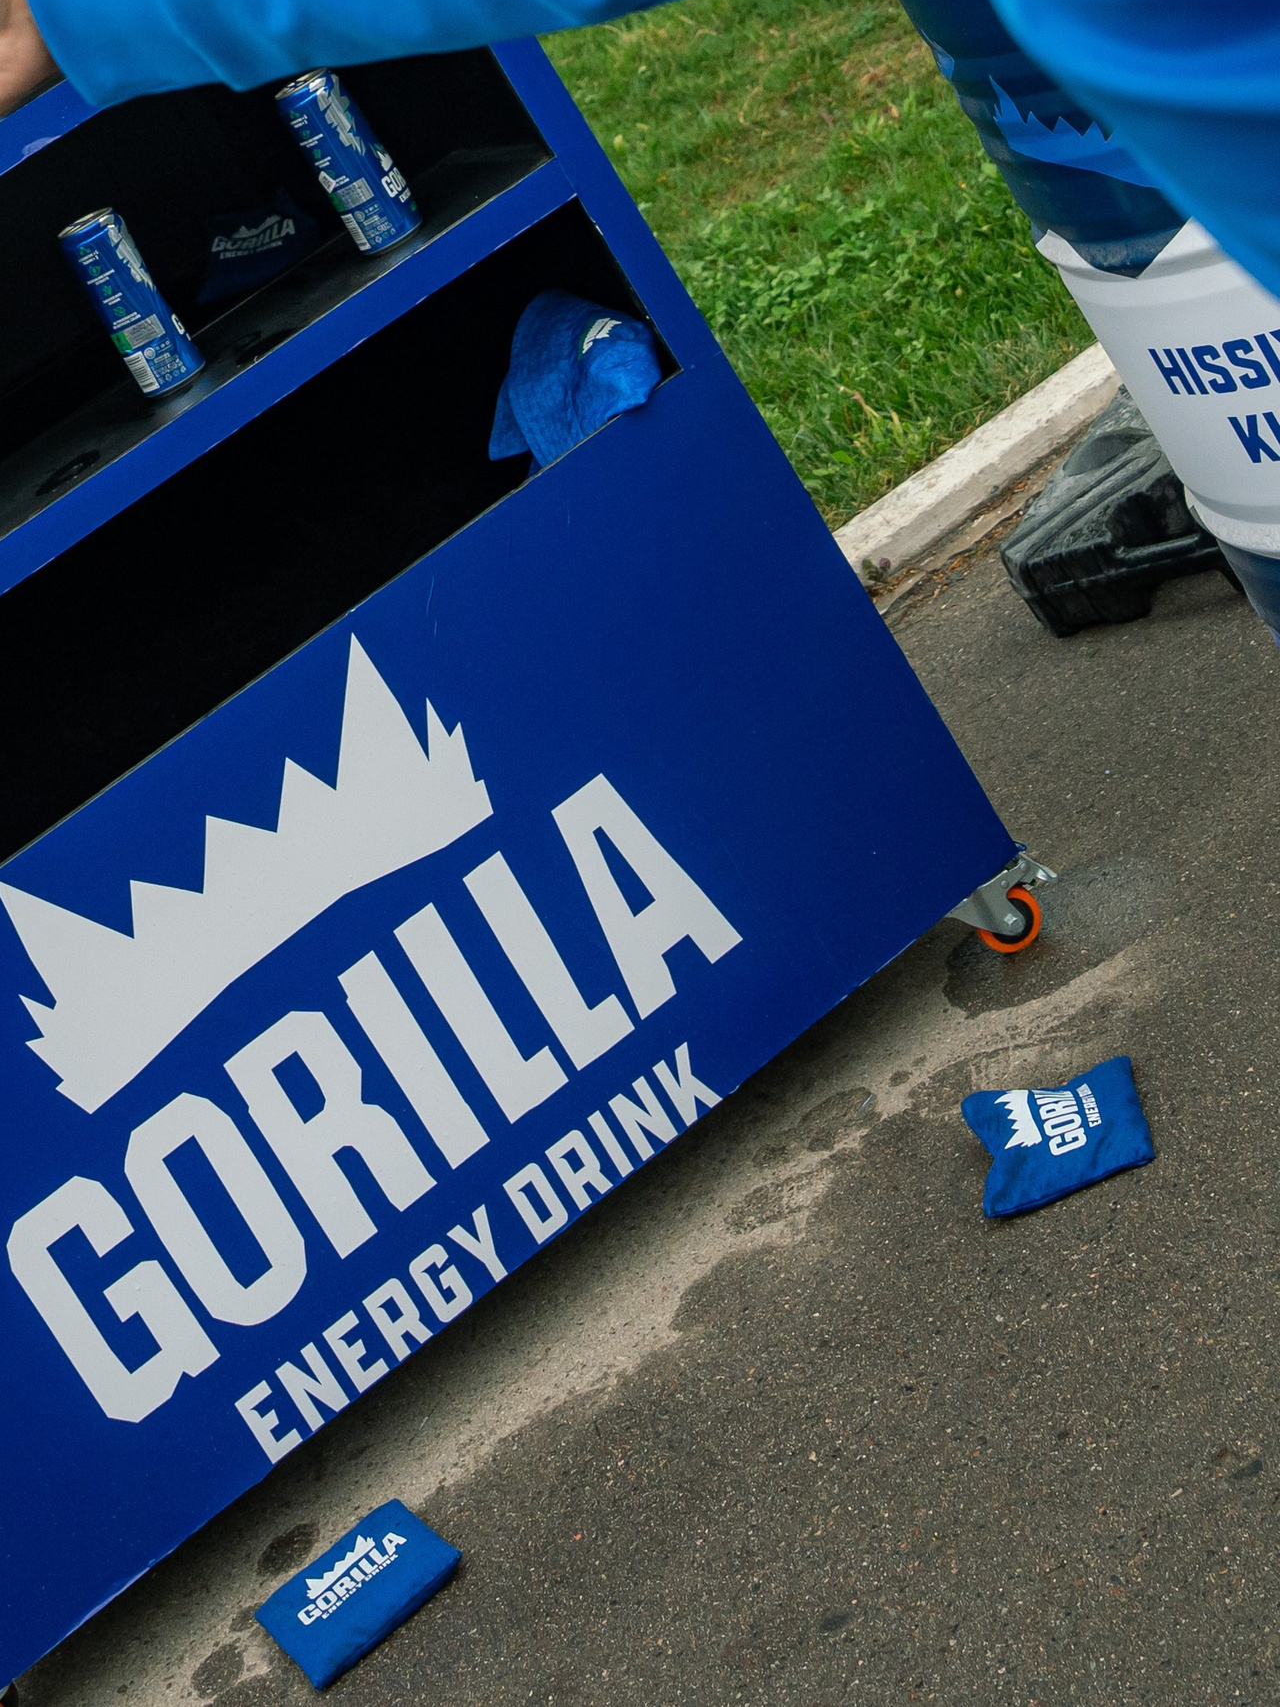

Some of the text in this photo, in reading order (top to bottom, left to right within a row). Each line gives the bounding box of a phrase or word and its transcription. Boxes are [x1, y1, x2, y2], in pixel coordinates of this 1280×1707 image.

[6, 773, 744, 1423] GORILLA
[234, 1041, 723, 1465] ENERGY DRINK
[297, 1532, 407, 1626] GORILLA
